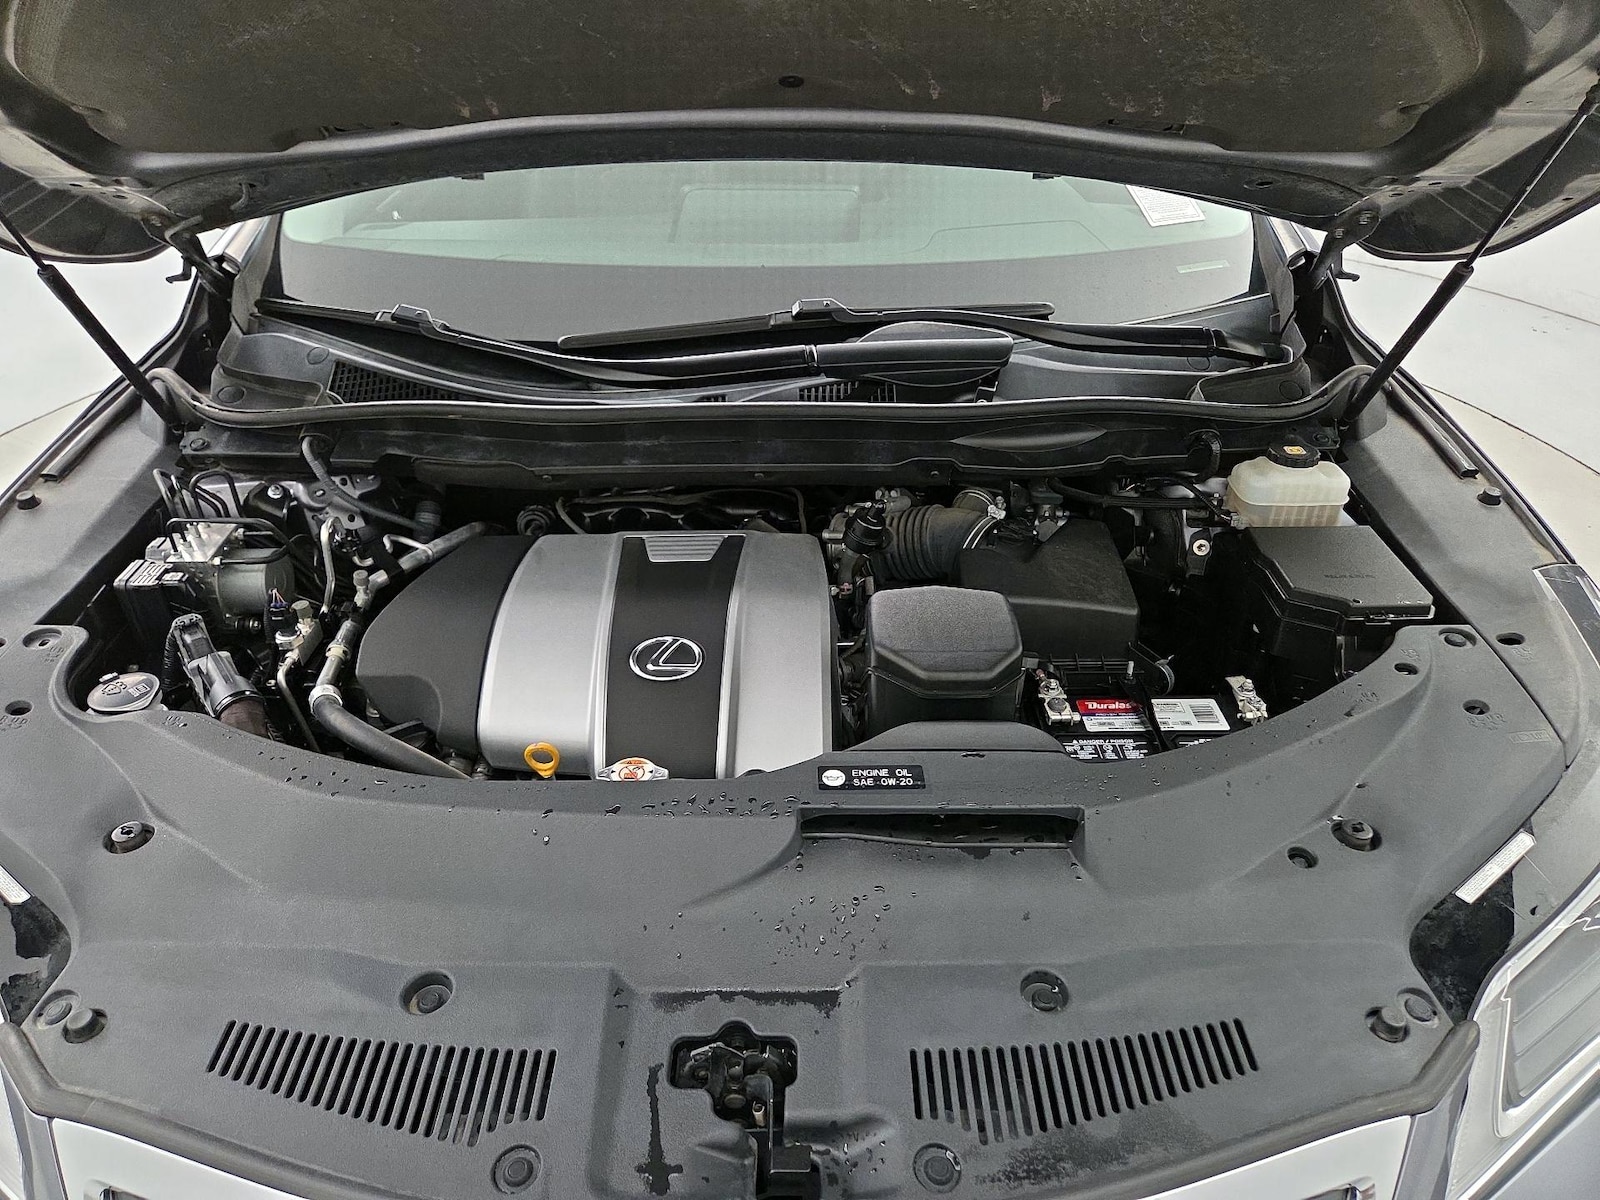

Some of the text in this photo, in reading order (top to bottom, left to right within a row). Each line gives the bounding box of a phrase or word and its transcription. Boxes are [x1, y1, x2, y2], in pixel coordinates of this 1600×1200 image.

[1084, 701, 1135, 710] Duralas
[851, 768, 913, 777] ENGINE OIL
[853, 777, 914, 786] SAE 0W-20
